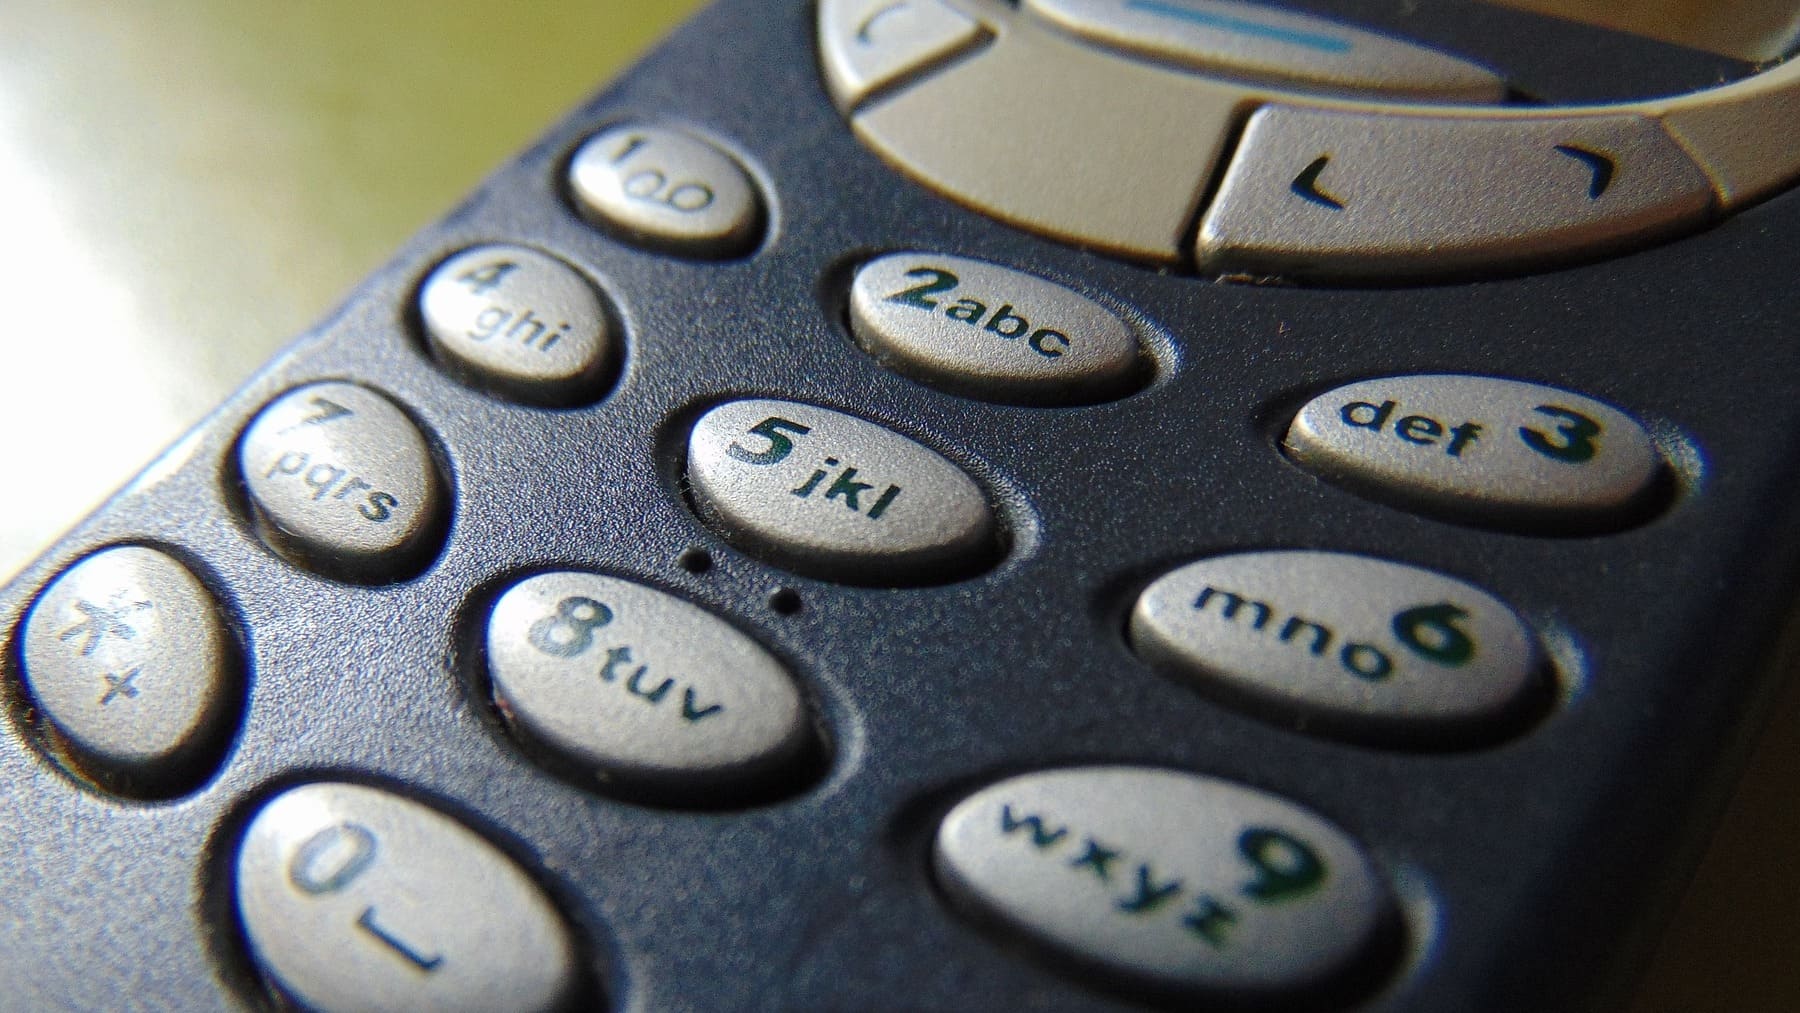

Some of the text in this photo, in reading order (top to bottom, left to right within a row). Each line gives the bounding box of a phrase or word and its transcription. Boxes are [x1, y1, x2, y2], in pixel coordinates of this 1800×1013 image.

[457, 259, 572, 351] 4 ghi
[884, 268, 1071, 361] 2 abc
[263, 395, 398, 523] 7 pqrs
[725, 416, 902, 520] 5 jkl
[1339, 399, 1602, 464] def 3
[528, 596, 725, 723] 8 tuv
[1193, 585, 1476, 683] mno 6
[288, 822, 378, 895] 0
[1000, 804, 1327, 946] wxyz 9
